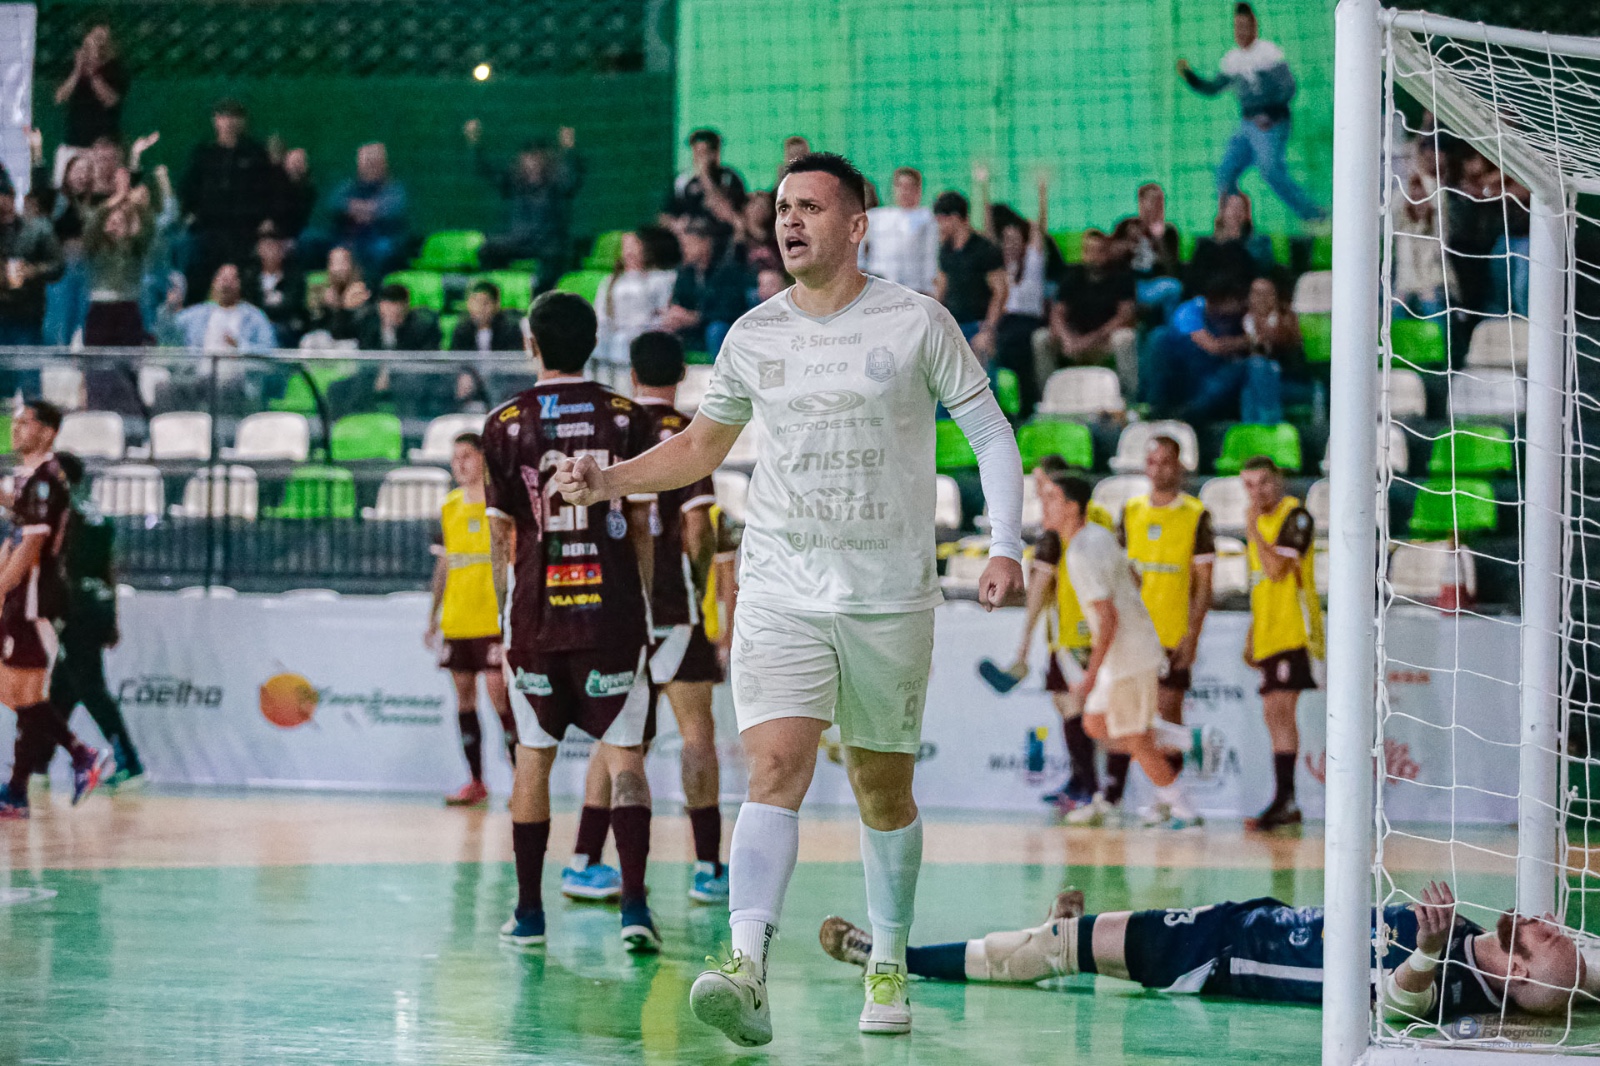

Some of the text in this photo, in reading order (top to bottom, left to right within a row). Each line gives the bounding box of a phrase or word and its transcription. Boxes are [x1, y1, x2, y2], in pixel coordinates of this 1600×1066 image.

[863, 303, 915, 315] coamo
[742, 315, 790, 330] coamo
[809, 333, 863, 348] Sicredi
[804, 361, 849, 376] FOCO
[776, 417, 885, 436] NORDESTE
[812, 534, 891, 551] UniCesumar
